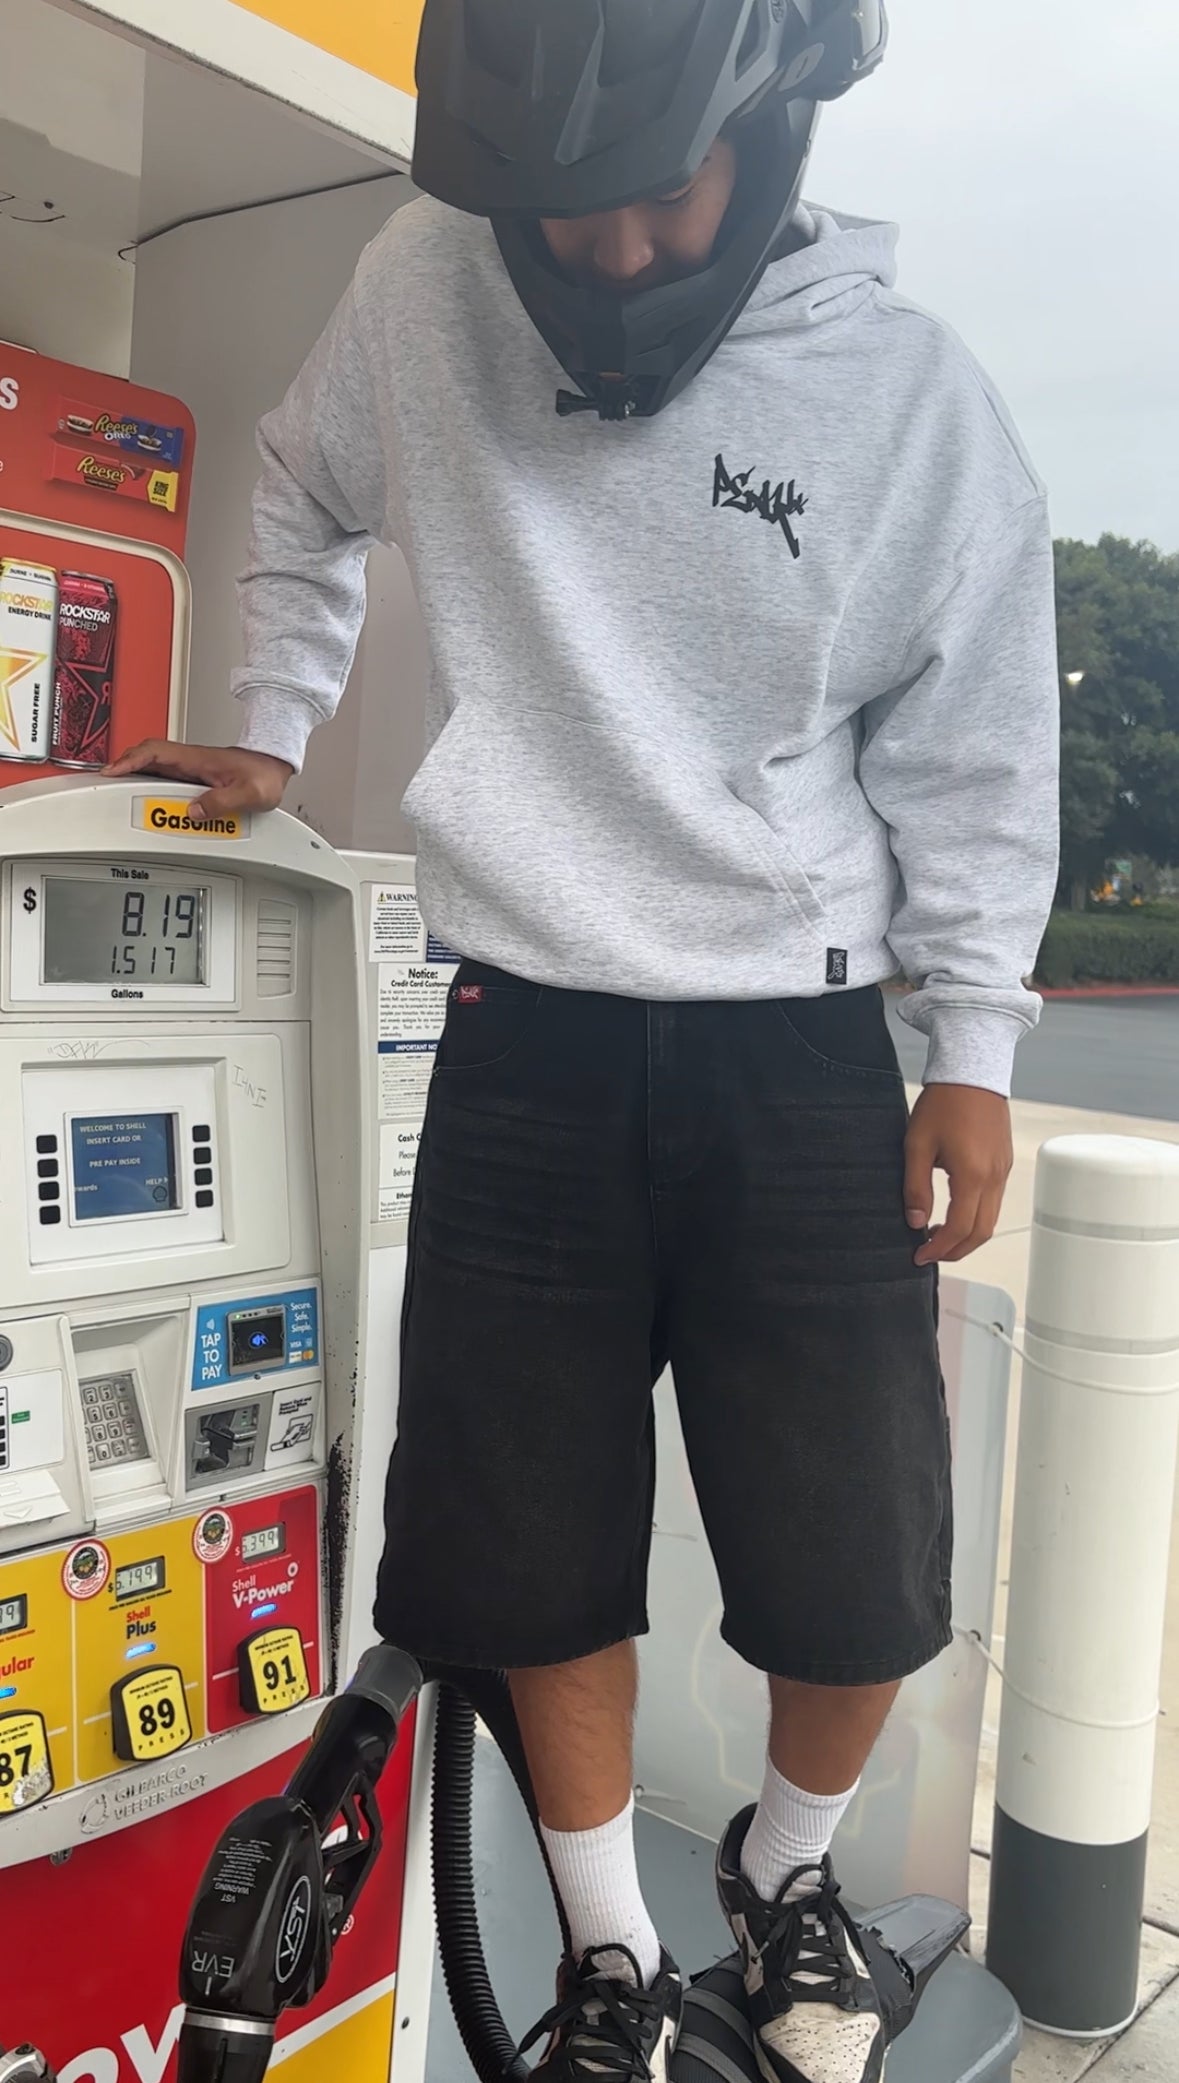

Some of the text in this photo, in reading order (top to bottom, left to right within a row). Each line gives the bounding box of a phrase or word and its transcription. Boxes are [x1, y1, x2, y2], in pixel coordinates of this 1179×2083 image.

[95, 414, 138, 435] Reese's
[77, 457, 125, 482] Reese's
[8, 606, 51, 620] ENERGY DRINK
[60, 604, 110, 623] ROCKSTAR
[60, 617, 98, 631] PUNCHED
[31, 709, 39, 742] SUGAR
[111, 868, 149, 880] This Sale
[121, 892, 196, 938] 8.19
[111, 946, 176, 974] 1.517
[408, 968, 438, 979] Notice:
[111, 989, 144, 1000] Gallons
[80, 1125, 113, 1133] WELCOME
[116, 1123, 125, 1131] TO
[86, 1136, 110, 1145] INSERT
[112, 1135, 130, 1143] CARD
[398, 1133, 414, 1142] Cash
[89, 1157, 141, 1168] PRE PAY INSIDE
[399, 1151, 415, 1159] Please
[393, 1167, 411, 1177] Before
[290, 1302, 312, 1311] Secure.
[294, 1312, 309, 1321] Safe.
[291, 1323, 312, 1333] Simple.
[201, 1332, 221, 1348] TAP
[203, 1349, 219, 1363] TO
[201, 1364, 222, 1380] PAY
[232, 1575, 256, 1592] Shell
[232, 1580, 294, 1609] V-Power
[126, 1606, 151, 1623] Shell
[126, 1621, 156, 1639] Plus
[0, 1656, 35, 1679] ular
[263, 1655, 296, 1690] 91
[139, 1698, 175, 1736] 89
[214, 1882, 249, 1895] WARNING
[192, 1951, 234, 1978] EVR
